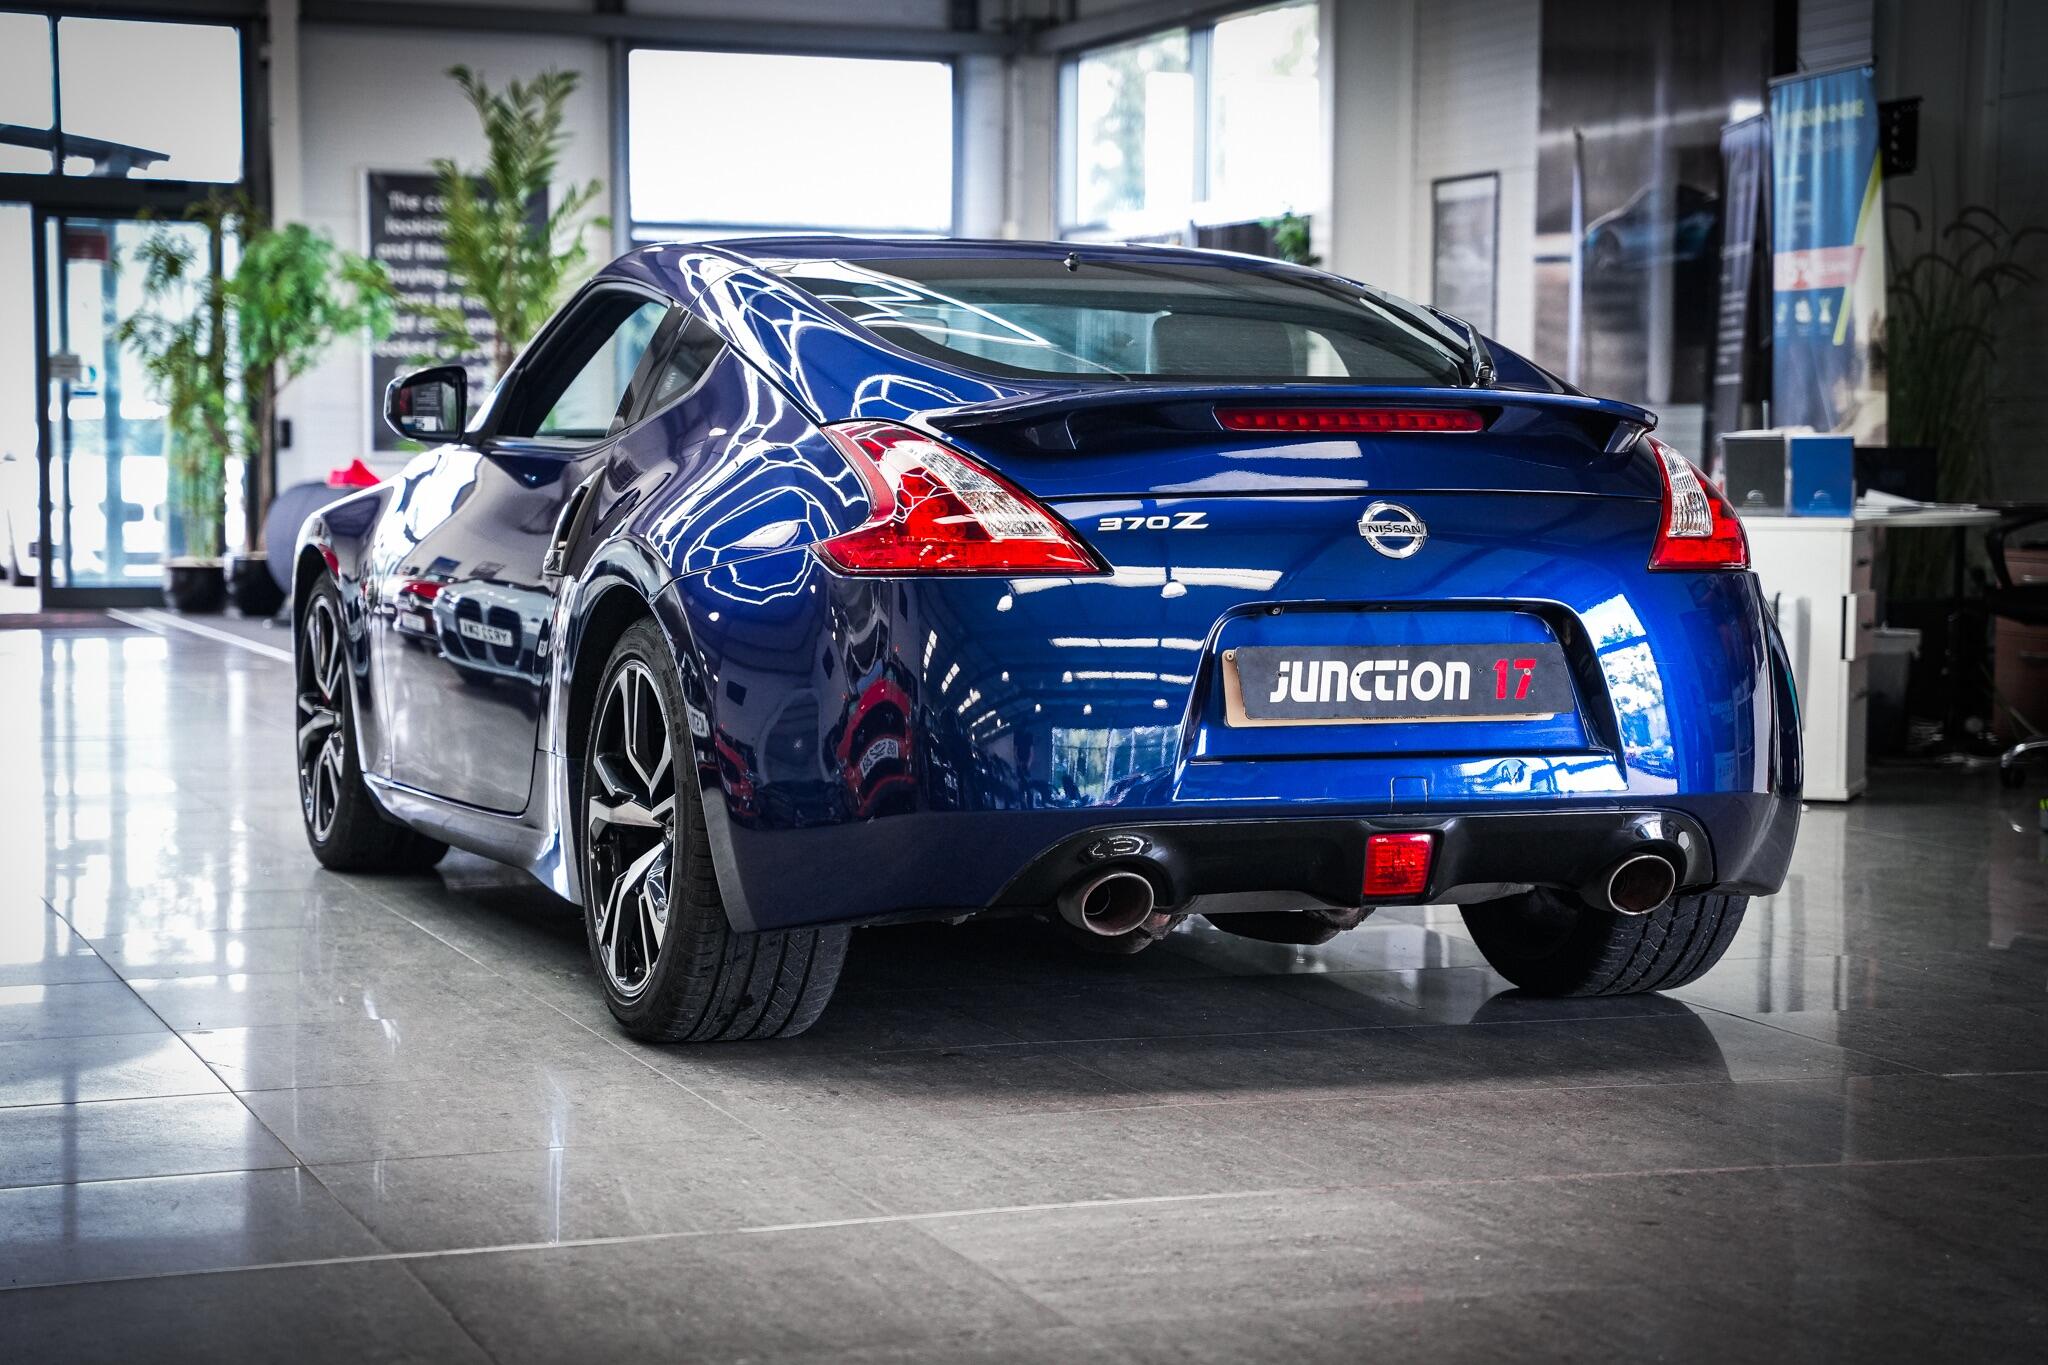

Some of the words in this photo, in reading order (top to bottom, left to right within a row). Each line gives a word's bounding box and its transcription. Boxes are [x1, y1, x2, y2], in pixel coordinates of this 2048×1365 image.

[1097, 512, 1209, 531] 370Z
[1367, 524, 1421, 534] NISSAN
[1492, 658, 1537, 700] 17
